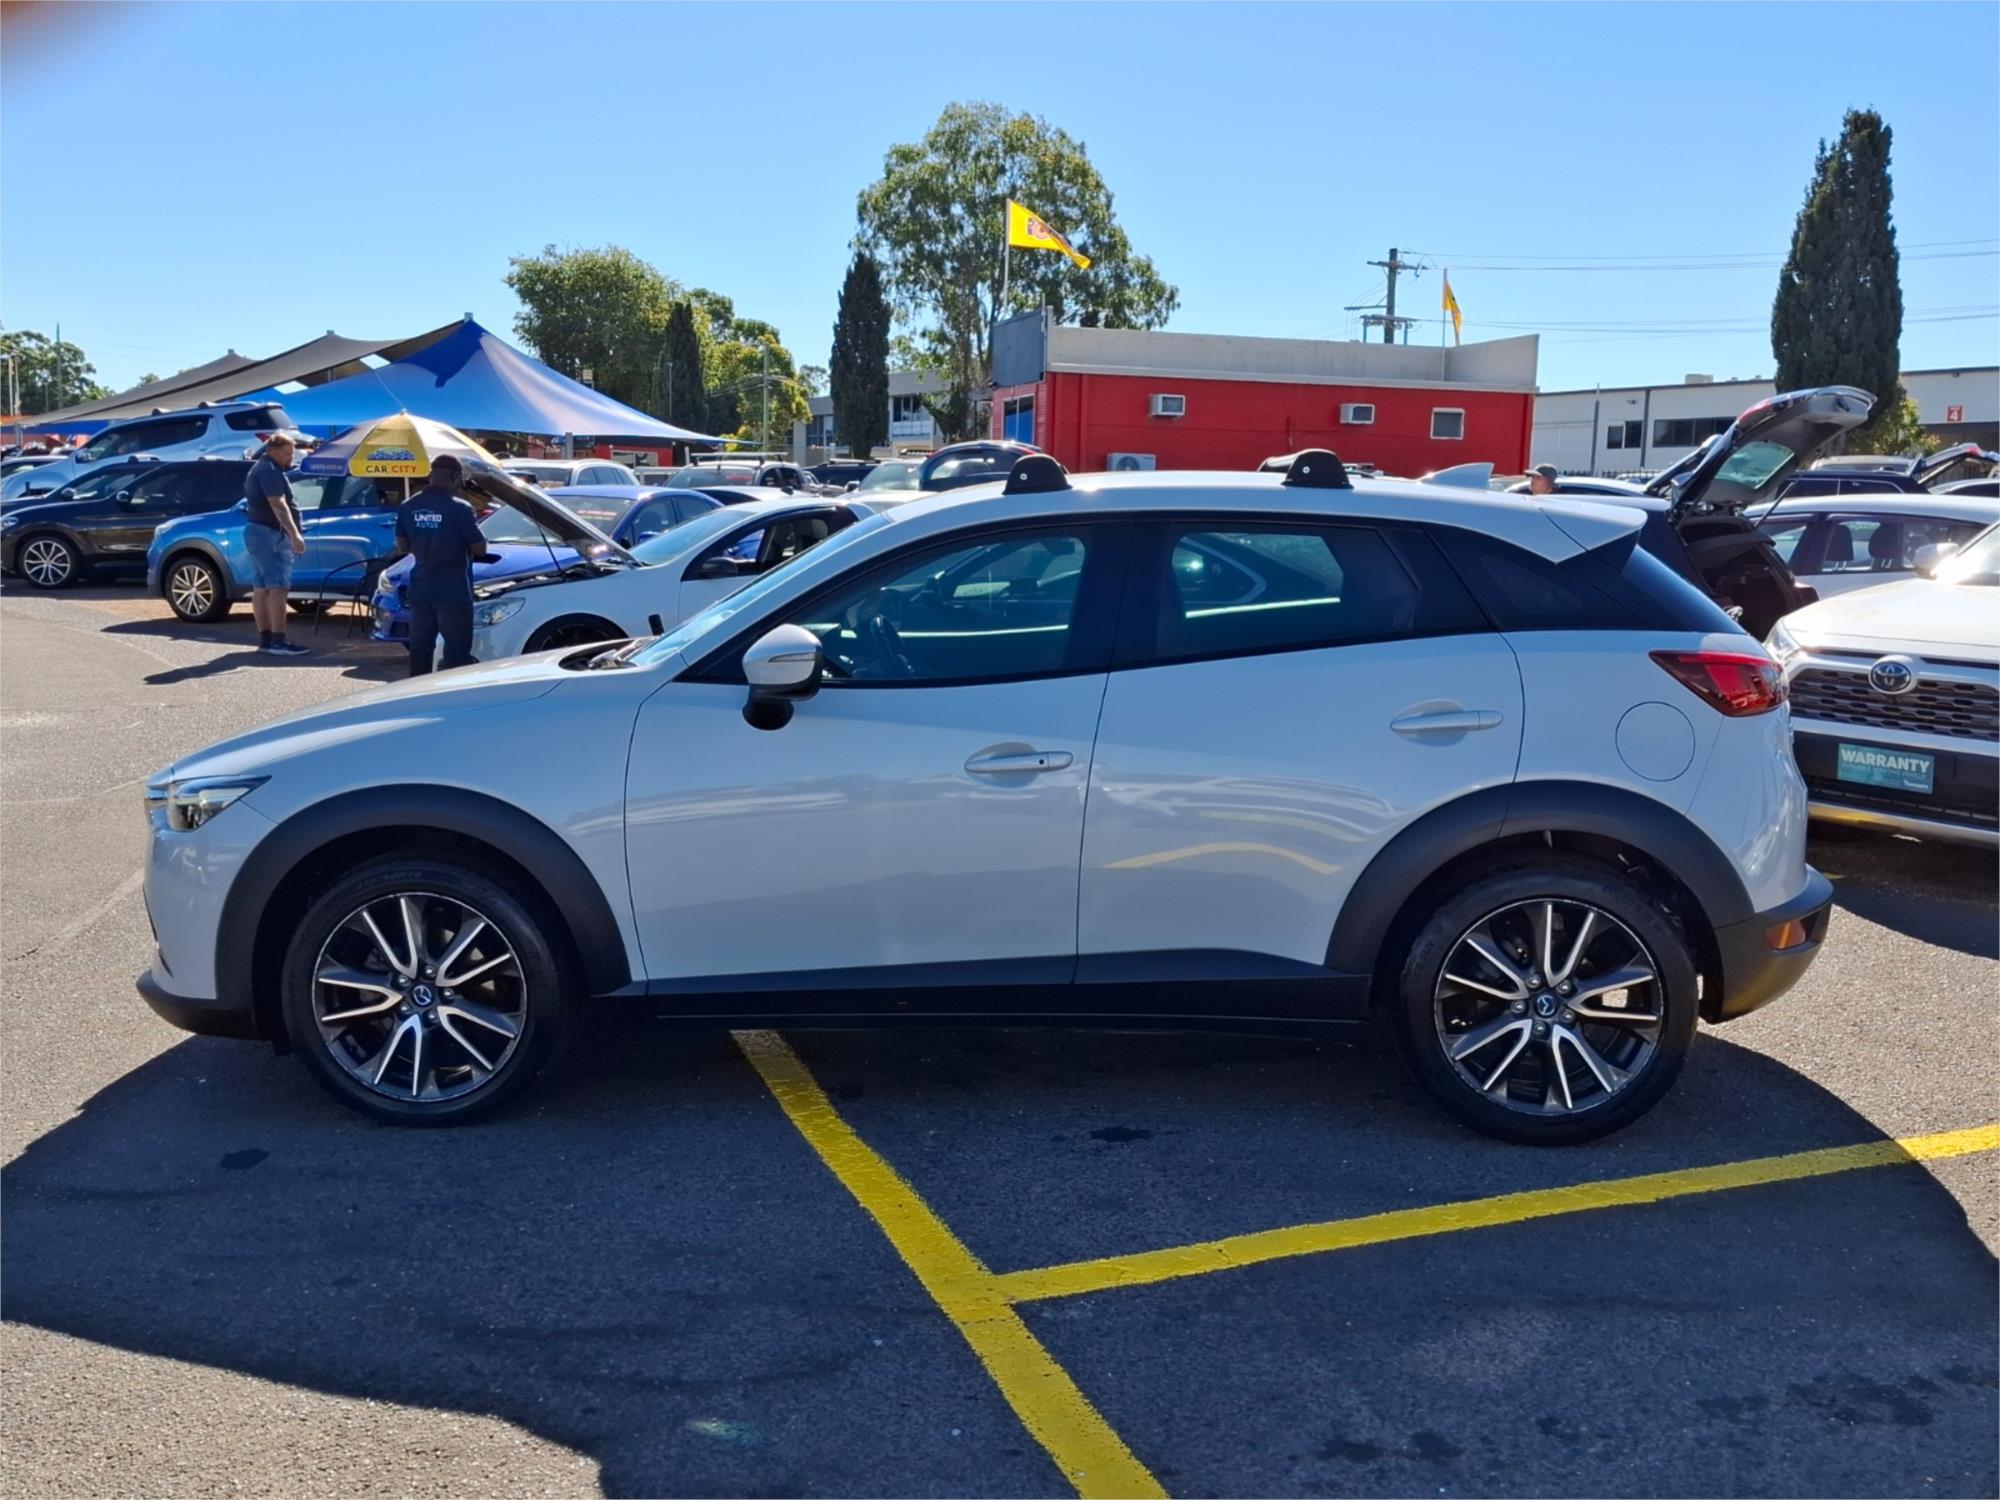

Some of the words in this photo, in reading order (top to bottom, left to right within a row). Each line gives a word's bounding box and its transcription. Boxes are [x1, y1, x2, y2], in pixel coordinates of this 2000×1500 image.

[1950, 411, 1958, 420] 4
[365, 465, 388, 473] CAR
[391, 464, 417, 473] CITY
[414, 514, 442, 522] UNITED
[1841, 749, 1930, 773] WARRANTY
